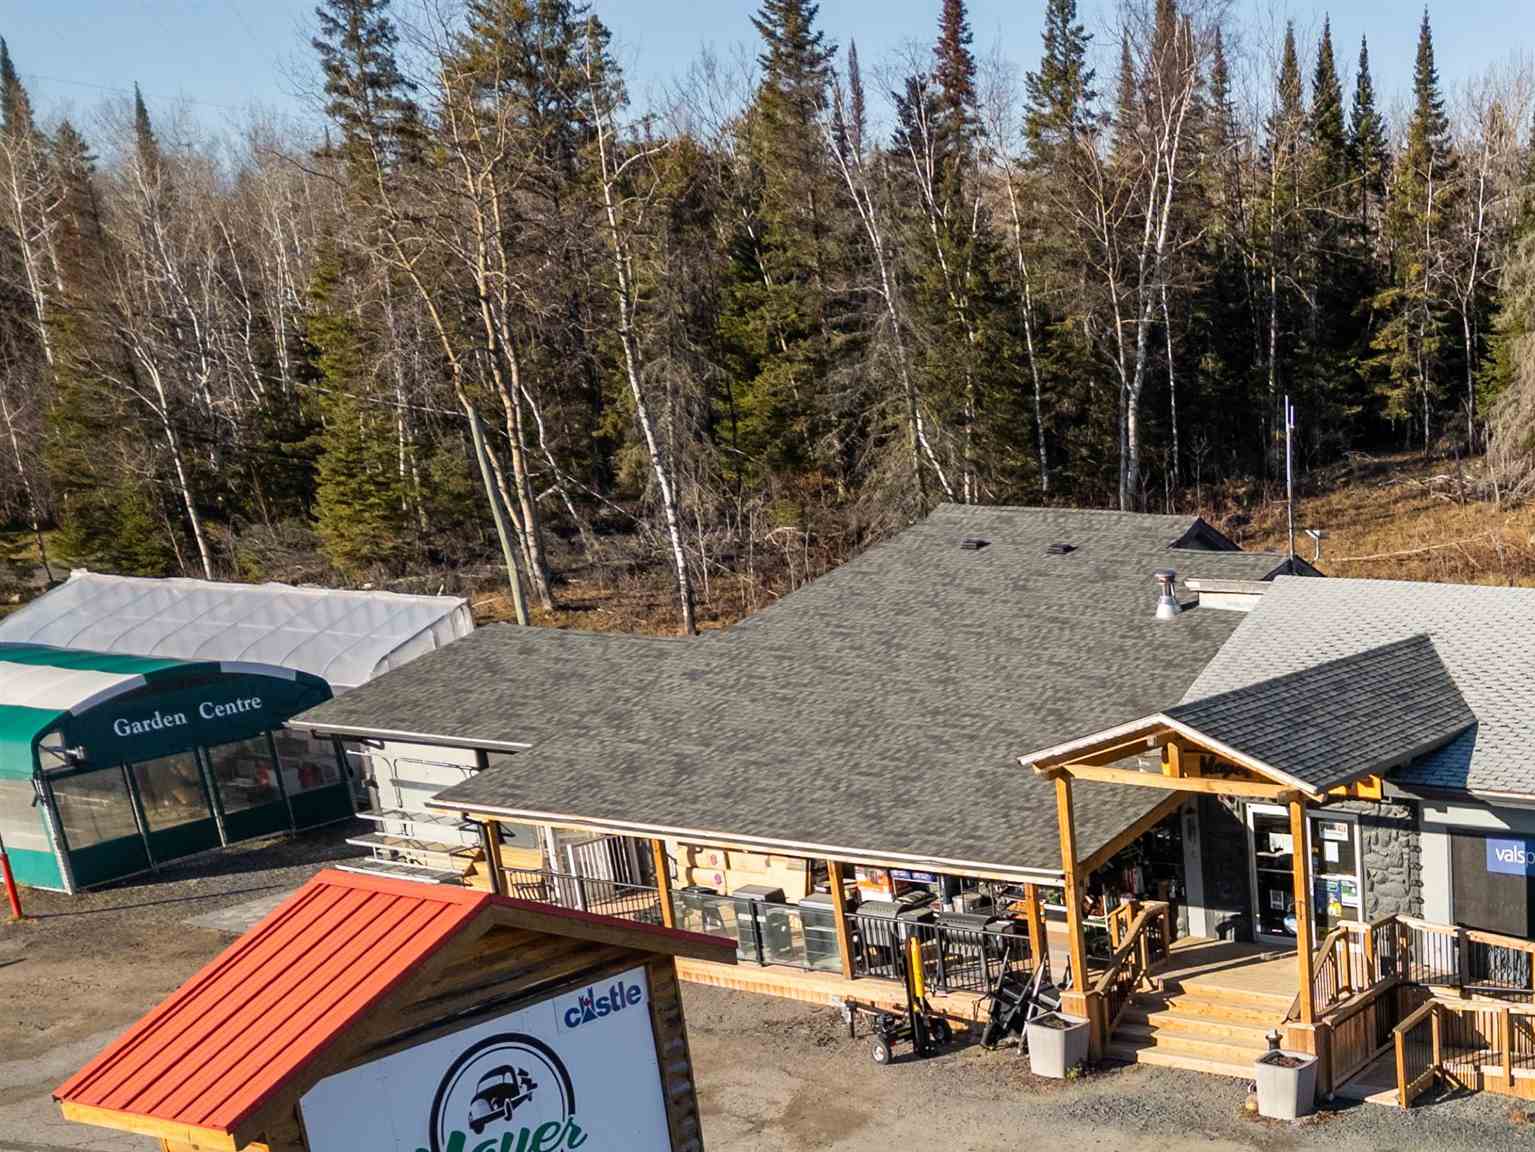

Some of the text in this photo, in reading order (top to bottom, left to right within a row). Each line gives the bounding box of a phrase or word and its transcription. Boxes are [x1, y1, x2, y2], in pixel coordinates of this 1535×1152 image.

[113, 697, 263, 737] Garden Centre
[564, 981, 642, 1028] castle
